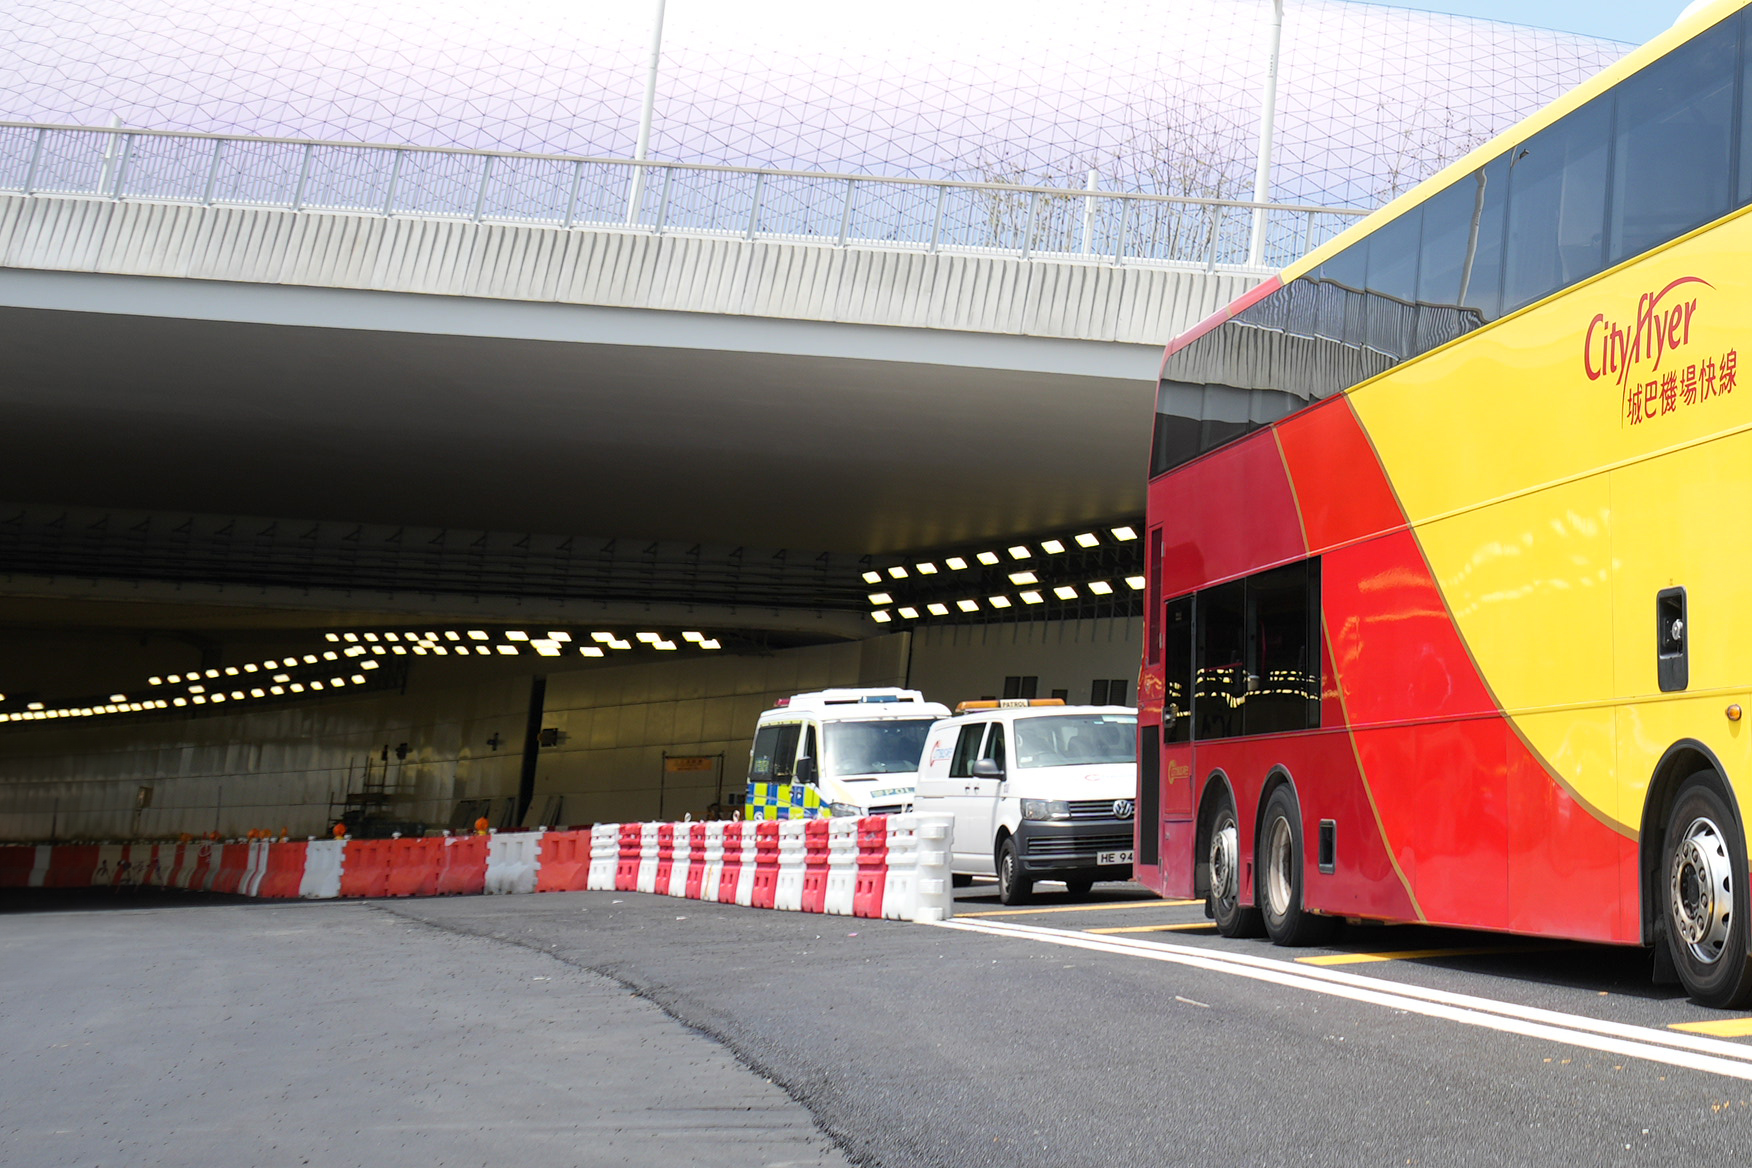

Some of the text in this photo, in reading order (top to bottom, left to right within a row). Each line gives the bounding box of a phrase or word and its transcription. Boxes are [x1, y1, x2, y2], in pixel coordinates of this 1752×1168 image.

[1626, 347, 1738, 426] 城巴機場快線
[1101, 853, 1115, 863] HE
